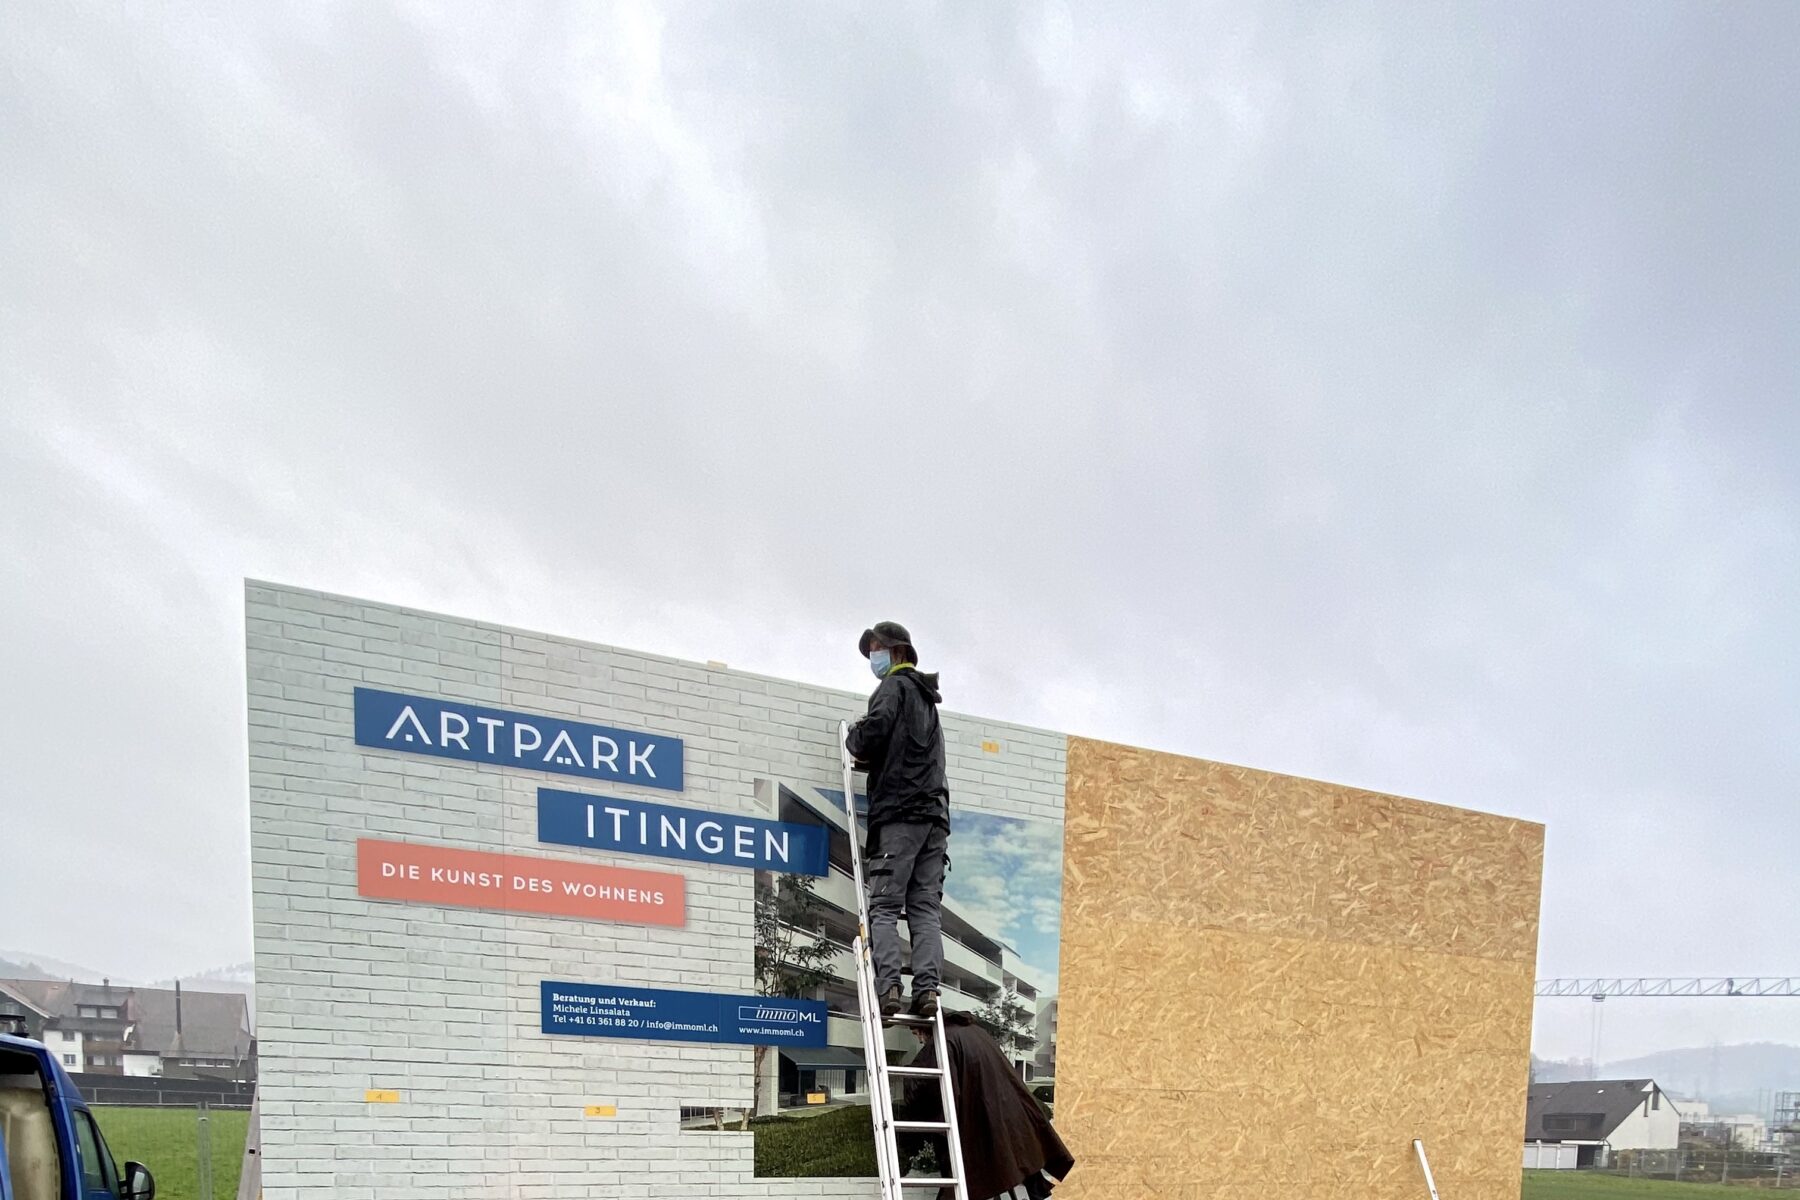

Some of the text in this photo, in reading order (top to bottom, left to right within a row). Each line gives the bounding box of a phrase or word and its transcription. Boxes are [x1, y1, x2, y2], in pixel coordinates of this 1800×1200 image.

[385, 705, 657, 779] ARTPARK
[586, 803, 790, 864] ITINGEN
[381, 862, 665, 906] DIE KUNST DES WOHNENS
[552, 993, 657, 1008] Beratung und Verkauf:
[553, 1004, 631, 1017] Michele Linsalata
[553, 1015, 567, 1023] Tel
[569, 1016, 584, 1025] +41
[586, 1017, 596, 1025] 61
[598, 1018, 613, 1026] 361
[614, 1019, 626, 1027] 88
[628, 1019, 639, 1027] 20
[646, 1021, 718, 1032] info@immoml.ch
[739, 1026, 805, 1037] www.immoml.ch
